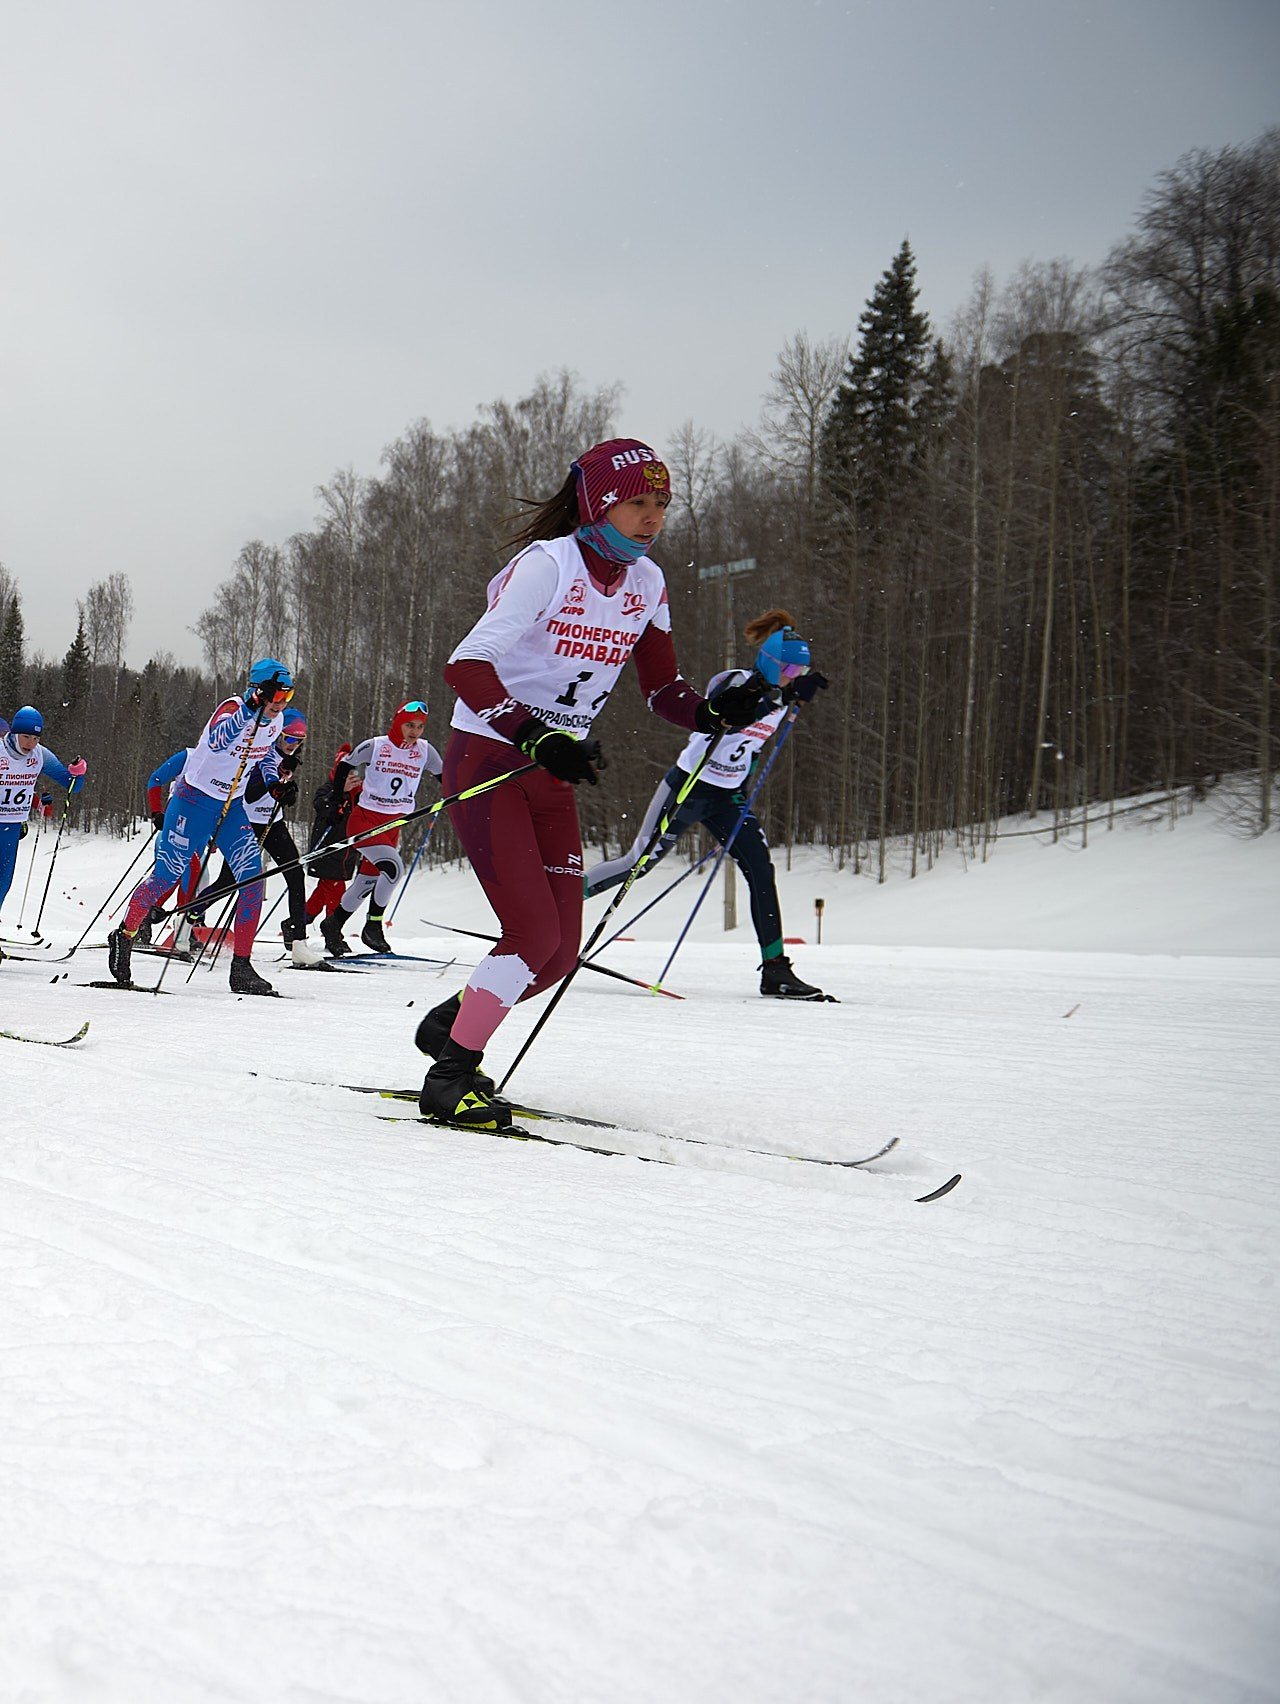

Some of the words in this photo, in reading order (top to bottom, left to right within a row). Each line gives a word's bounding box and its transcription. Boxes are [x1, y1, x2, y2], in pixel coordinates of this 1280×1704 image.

[554, 639, 631, 667] ПРАВДА
[554, 671, 594, 707] 1
[730, 740, 752, 762] 5
[1, 788, 26, 805] 16
[390, 777, 403, 796] 9
